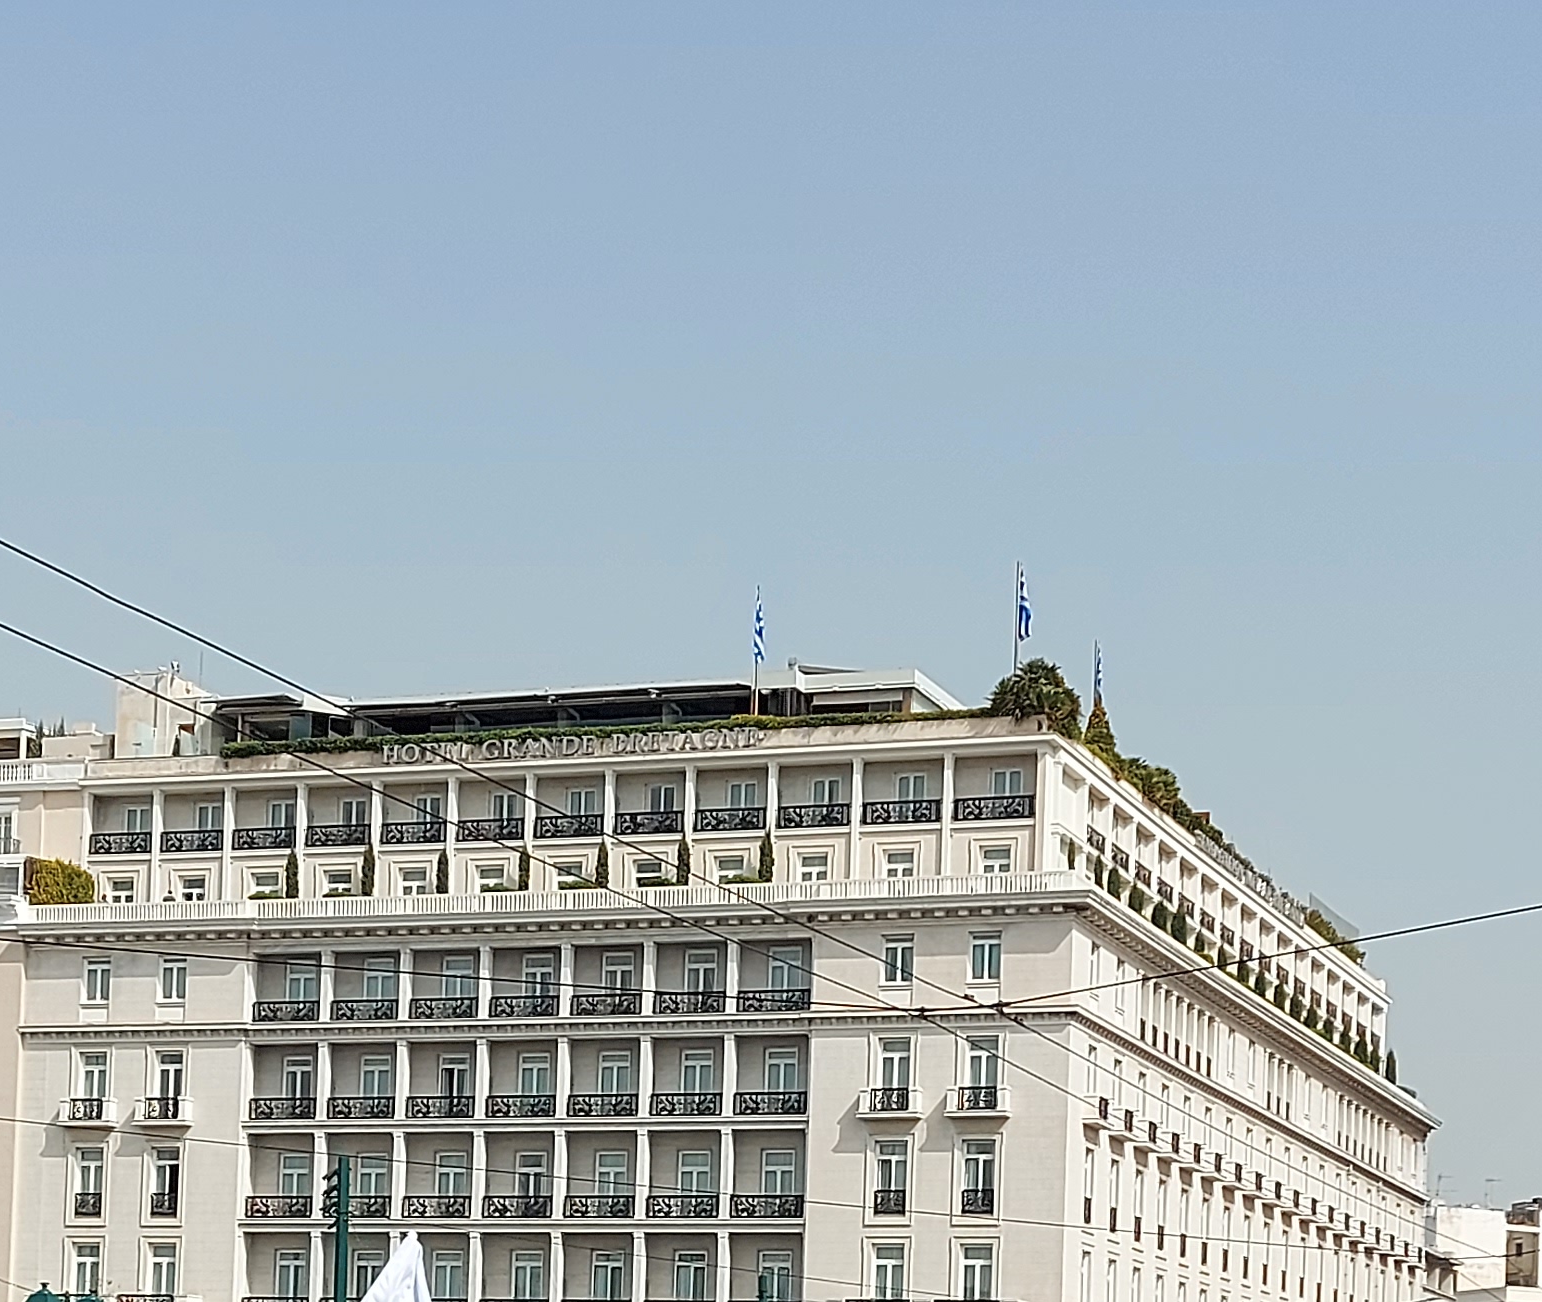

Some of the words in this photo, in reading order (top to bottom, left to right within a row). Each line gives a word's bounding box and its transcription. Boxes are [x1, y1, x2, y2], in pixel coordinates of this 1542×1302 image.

[381, 742, 468, 765] HOTEL
[482, 734, 596, 761] GRANDE
[613, 726, 759, 754] BRETAGNE
